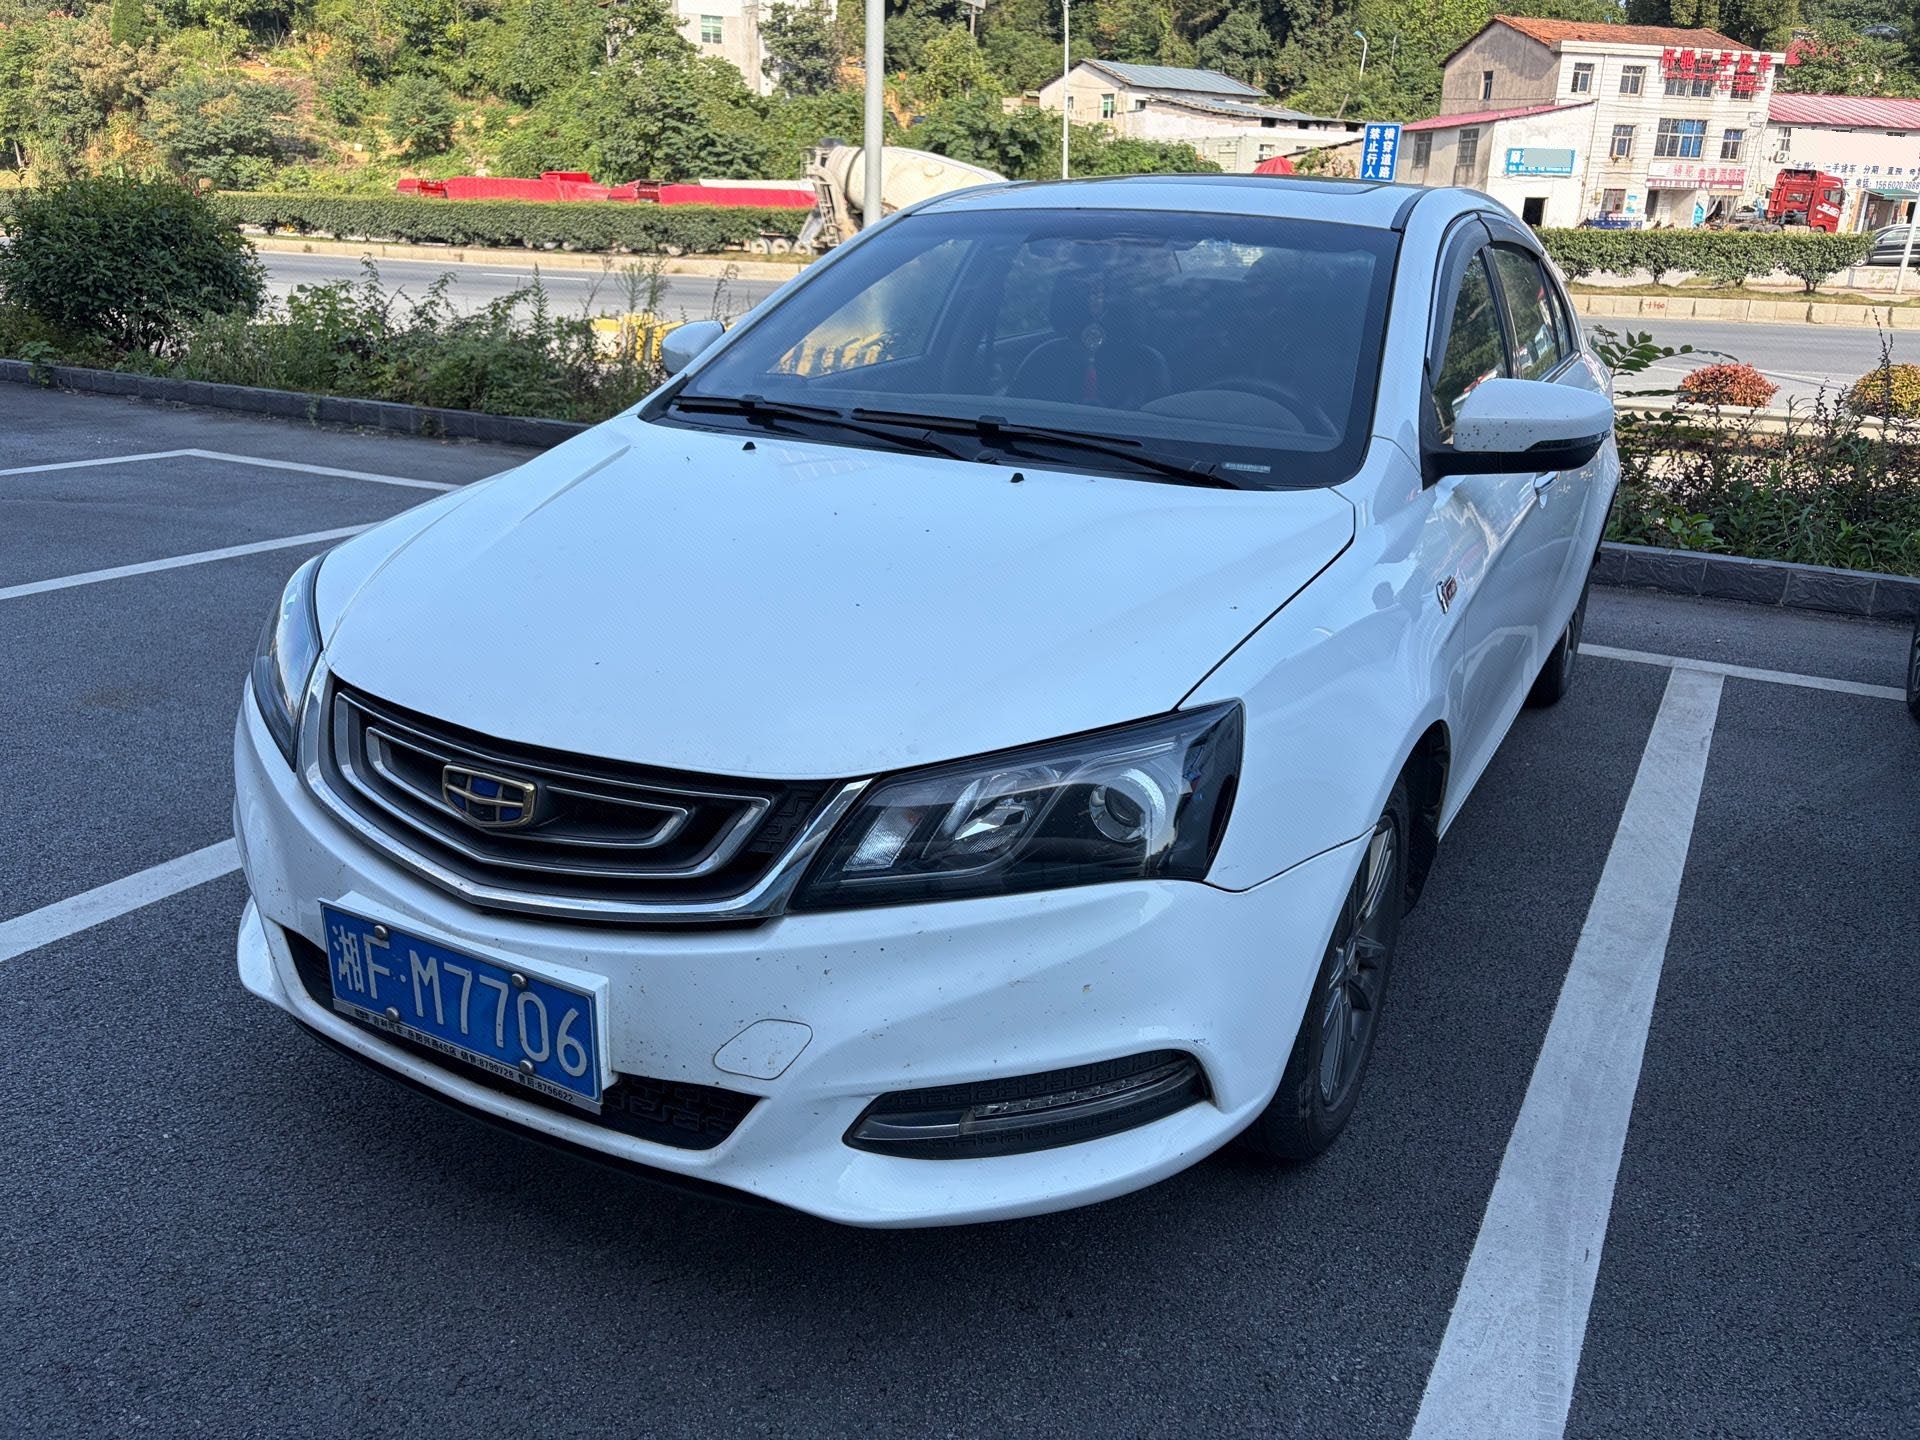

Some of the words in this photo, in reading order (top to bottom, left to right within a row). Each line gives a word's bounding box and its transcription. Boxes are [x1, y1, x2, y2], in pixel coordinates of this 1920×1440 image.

[1364, 127, 1381, 178] 禁止行人
[1378, 127, 1396, 179] 横穿道路
